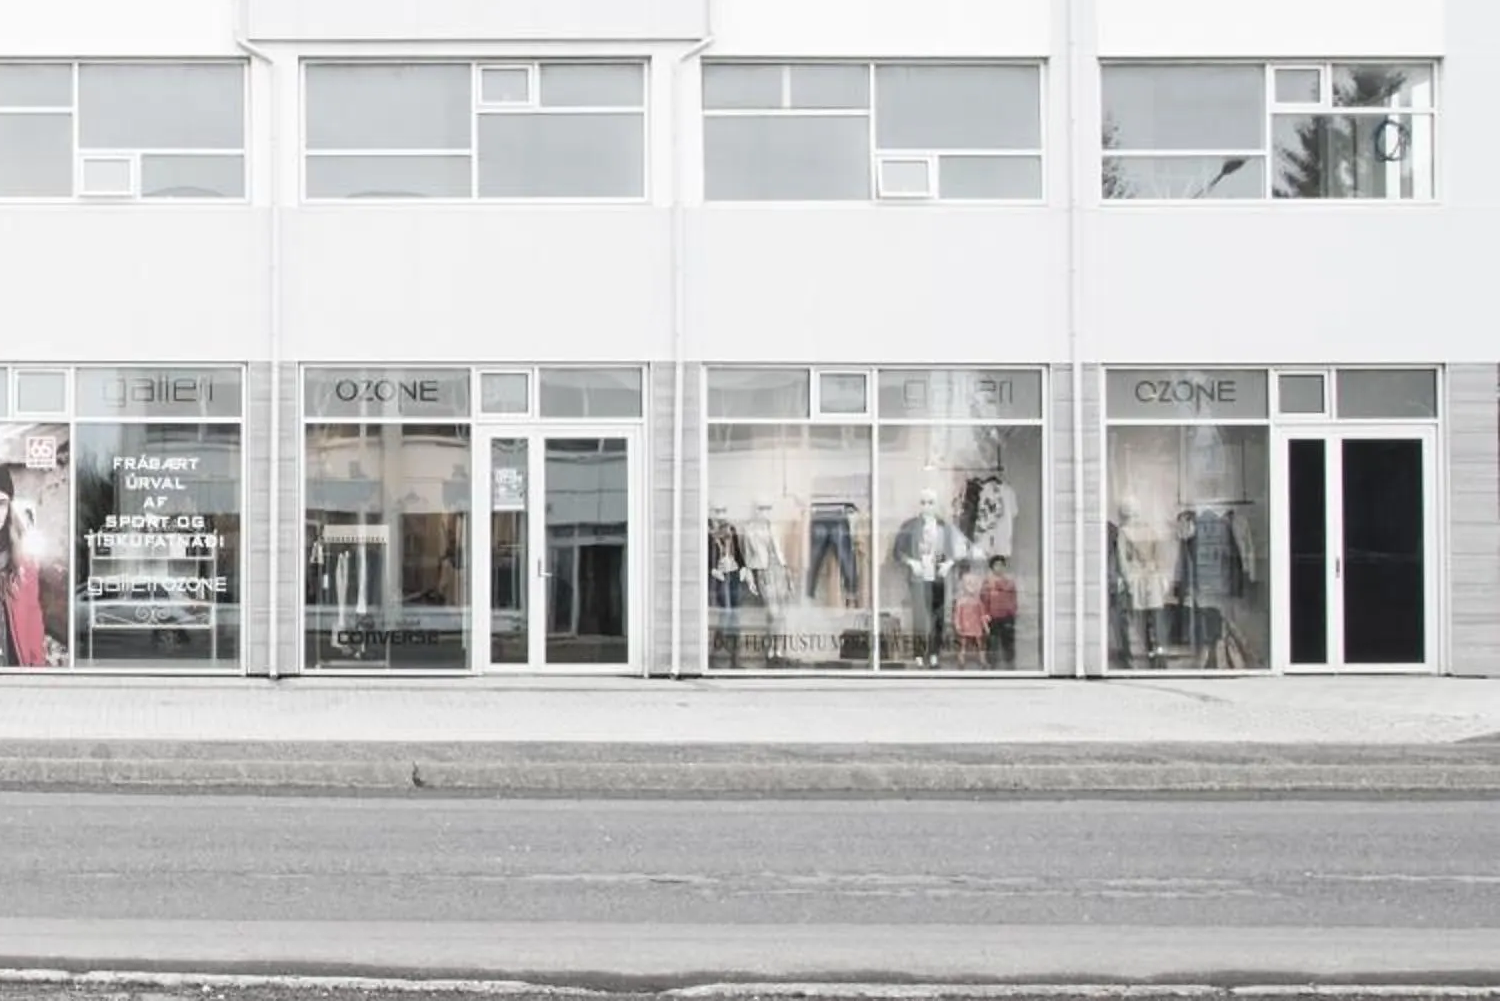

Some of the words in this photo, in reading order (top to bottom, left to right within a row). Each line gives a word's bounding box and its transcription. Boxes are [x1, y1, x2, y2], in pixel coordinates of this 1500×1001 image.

[336, 380, 438, 412] OZONE
[1135, 380, 1237, 413] OZONE
[143, 497, 168, 508] AF
[105, 515, 170, 528] SPORT
[177, 516, 205, 528] OG
